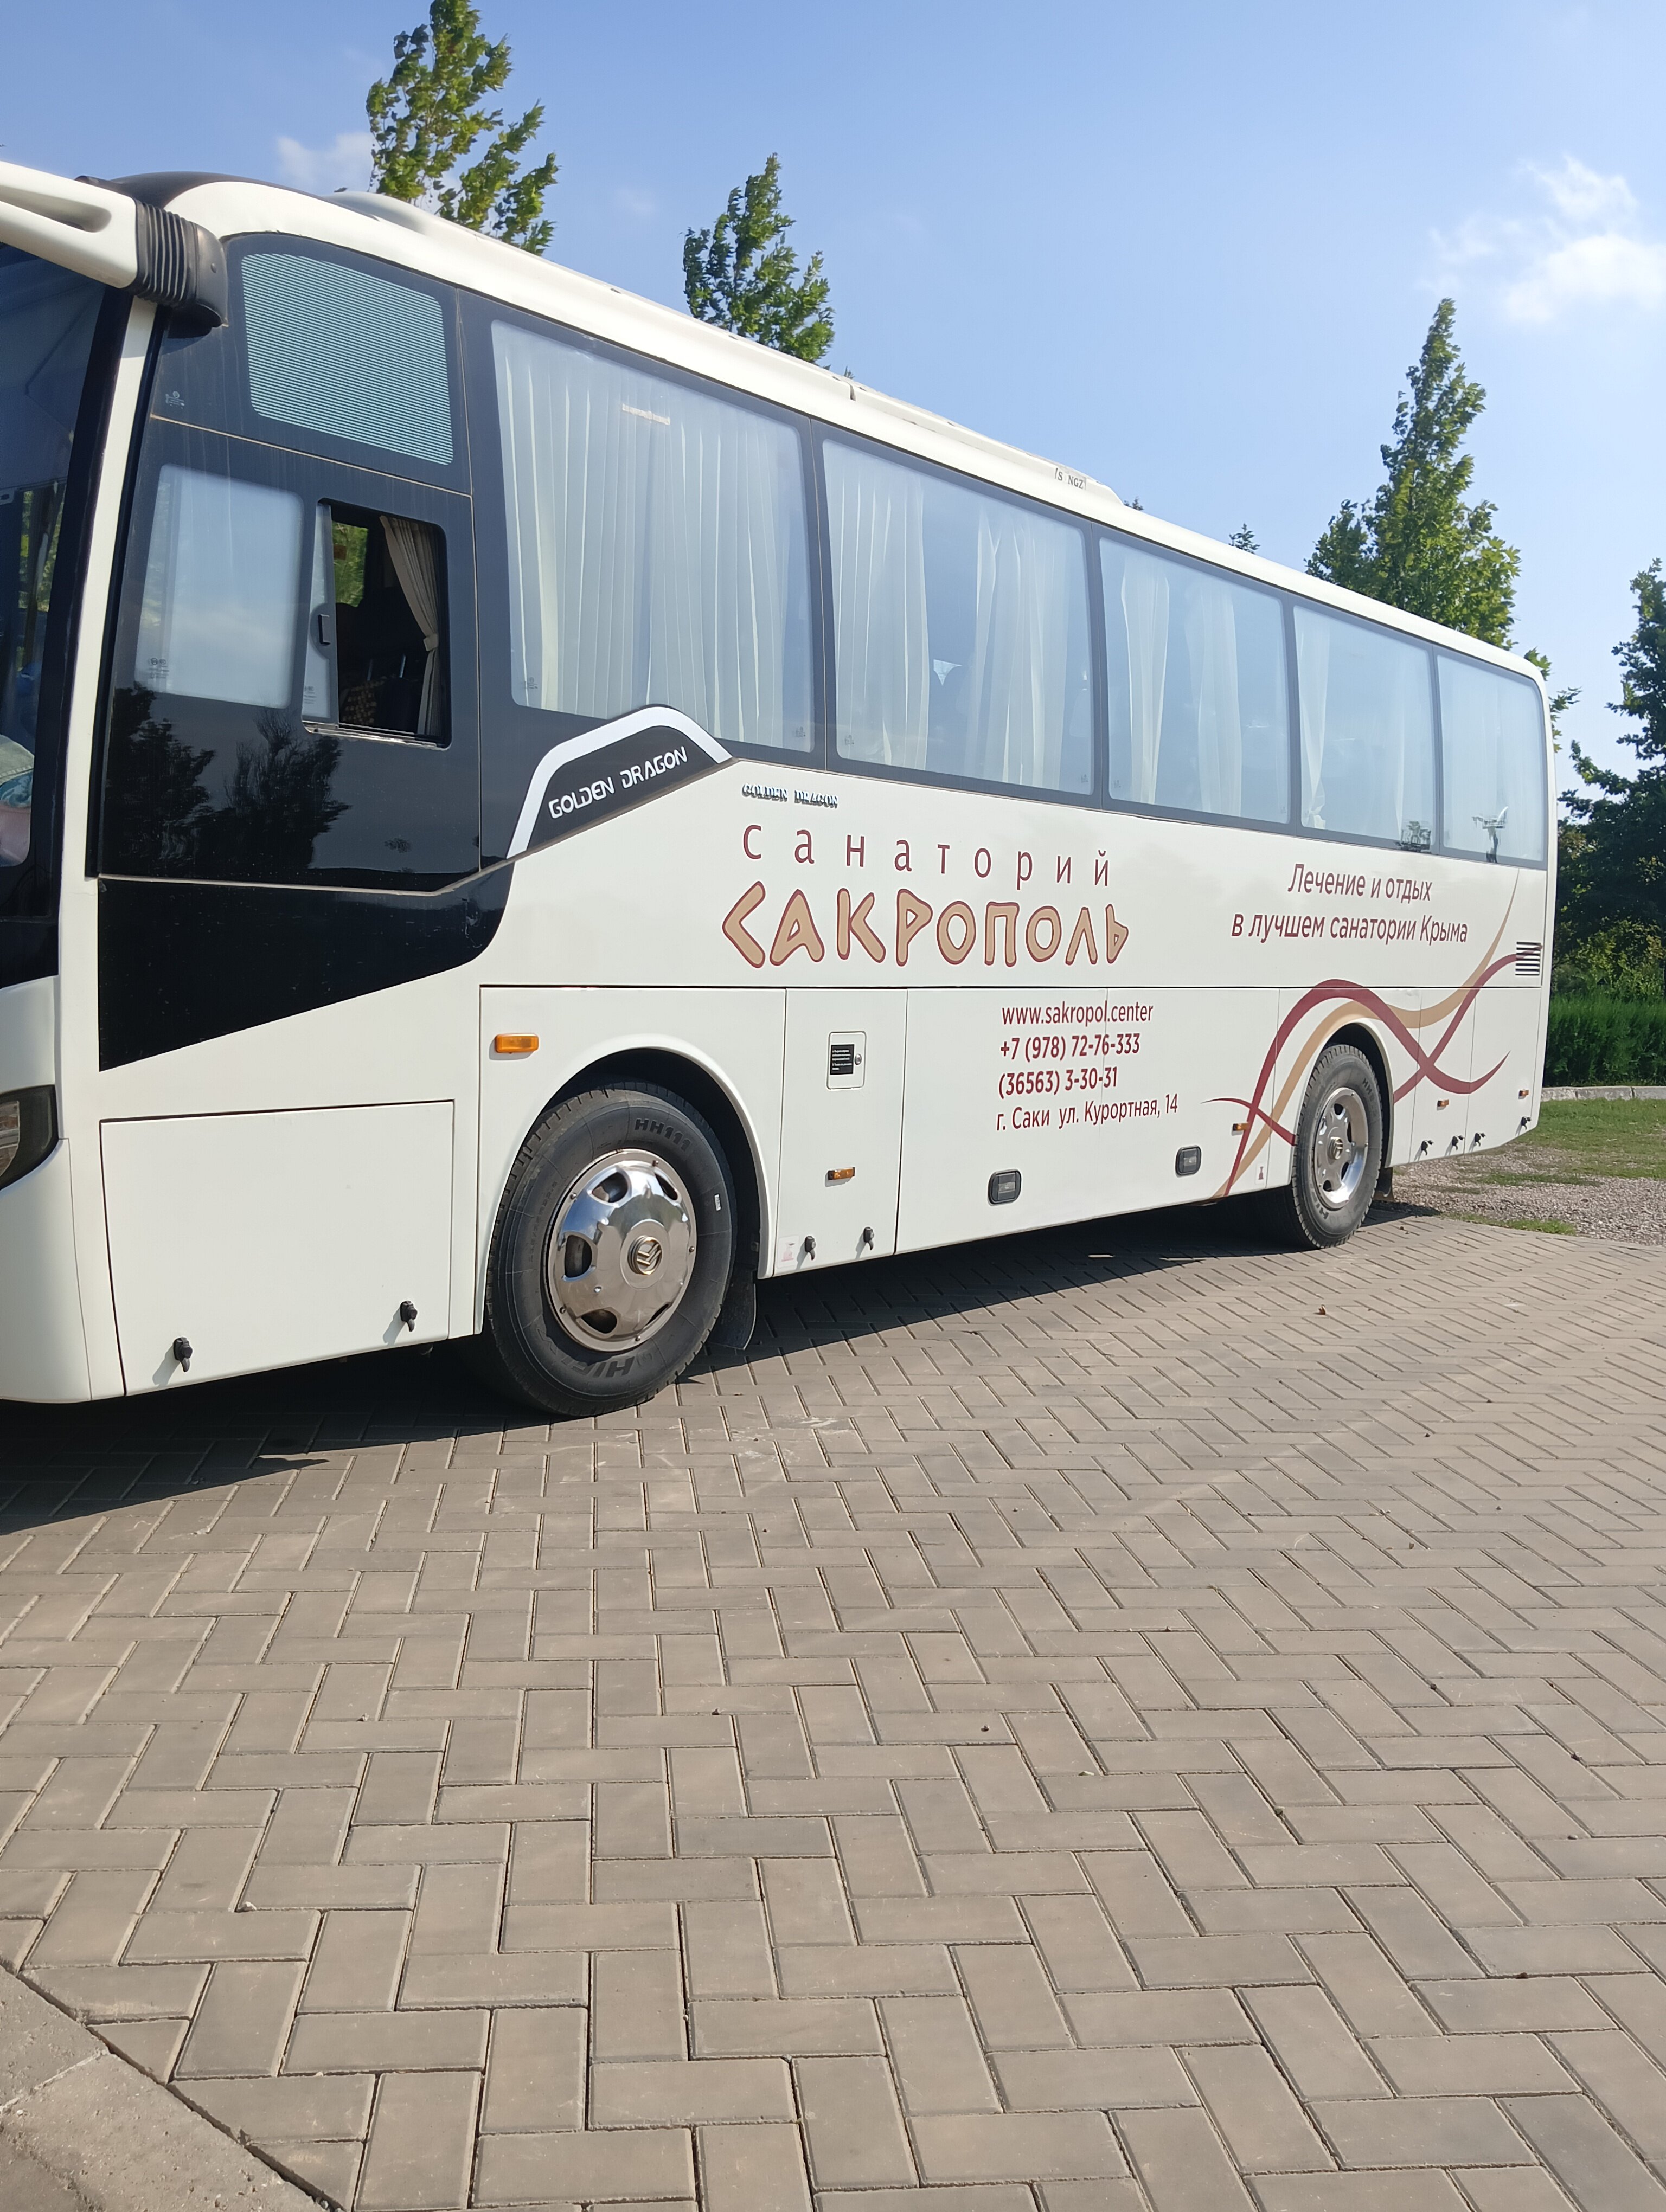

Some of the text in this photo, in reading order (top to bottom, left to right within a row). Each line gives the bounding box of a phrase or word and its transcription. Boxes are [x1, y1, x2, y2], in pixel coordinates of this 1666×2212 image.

[1058, 471, 1084, 490] SNGZ
[549, 746, 688, 819] GOLDEN DRAGON
[742, 783, 839, 809] GOLDEN DRAGON
[743, 824, 1109, 890] санаторий
[1287, 863, 1433, 904] Лечение и отдых
[722, 881, 1129, 968] САКРОПОЛЬ
[1248, 914, 1325, 943] лучшем
[1330, 916, 1417, 945] санатории
[1419, 915, 1468, 946] Крыма
[1002, 1000, 1154, 1027] www.sakropol.center
[1001, 1033, 1140, 1063] +7 (978) 72-76-333
[998, 1066, 1118, 1099] (36563) 3-30-31
[997, 1093, 1178, 1131] г. Саки ул. Курортная, 14
[635, 1118, 691, 1152] HH111
